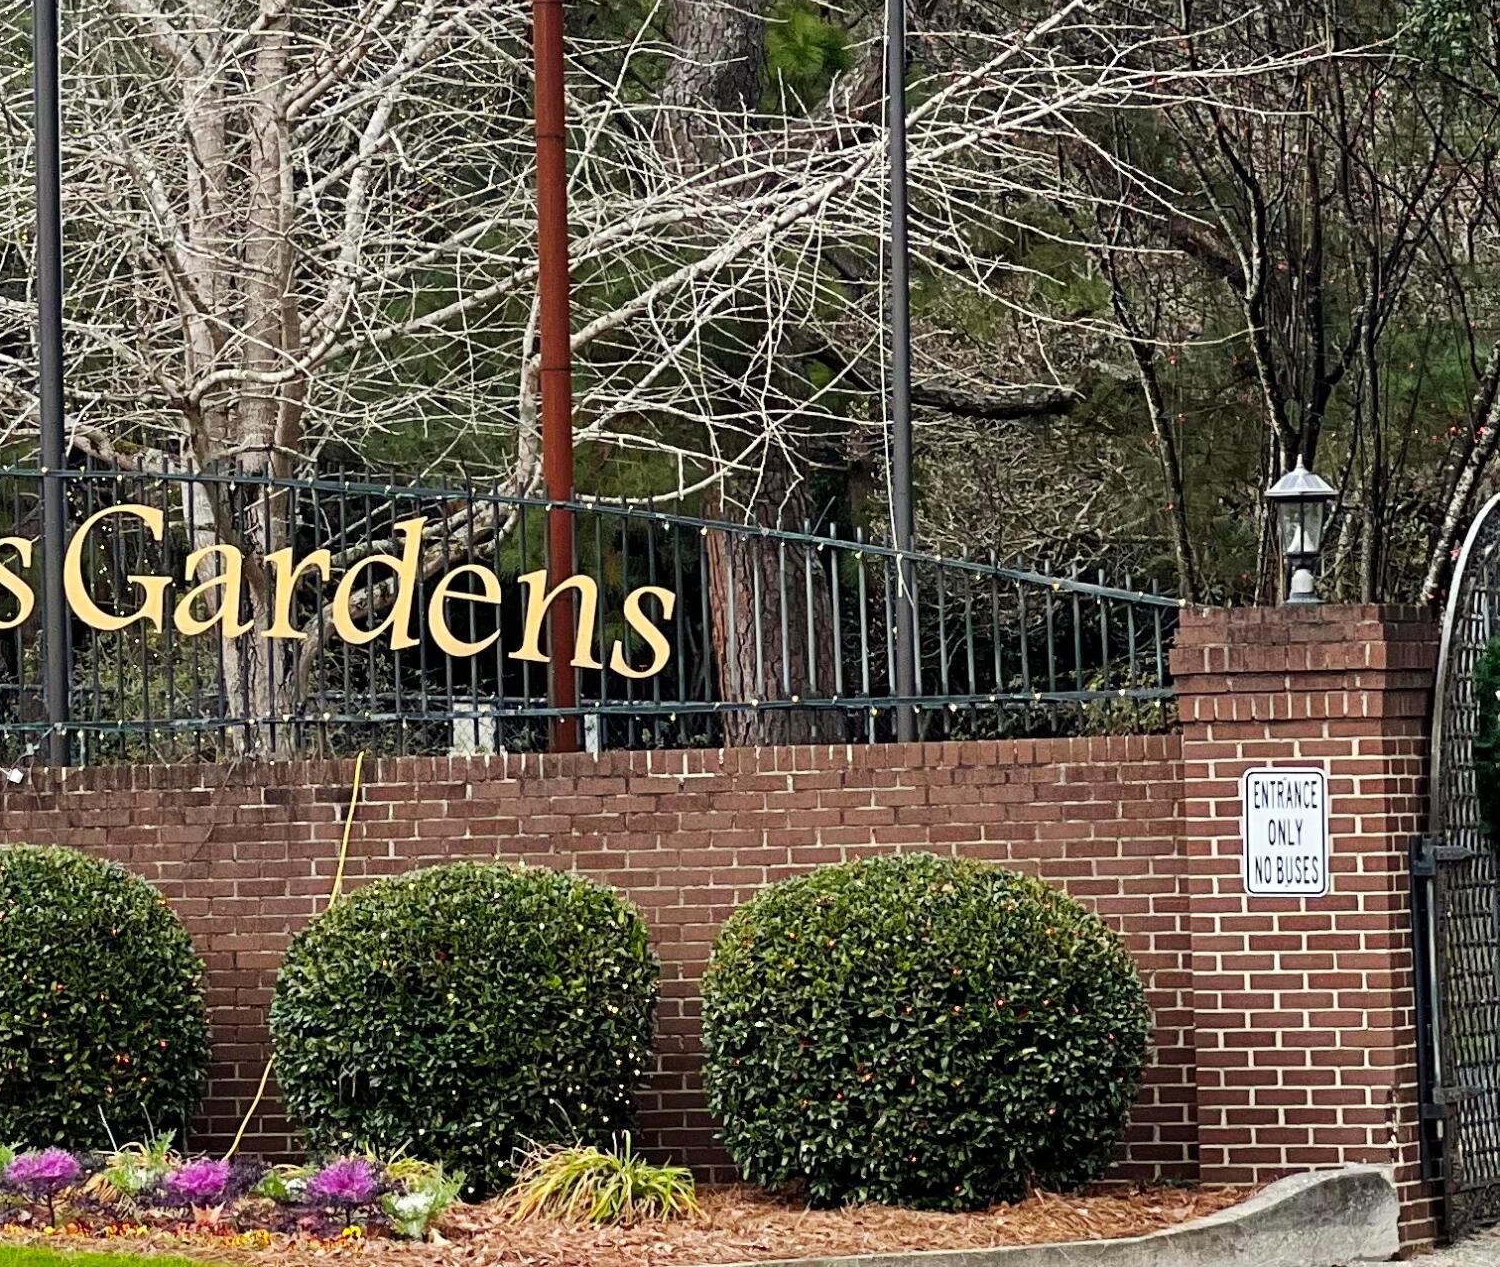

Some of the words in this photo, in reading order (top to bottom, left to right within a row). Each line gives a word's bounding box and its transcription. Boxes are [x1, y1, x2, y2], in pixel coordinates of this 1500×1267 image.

[64, 504, 677, 679] Gardens
[1254, 781, 1318, 809] ENTRANCE
[1268, 819, 1303, 845] ONLY
[1255, 856, 1272, 884] NO
[1277, 856, 1319, 884] BUSES
